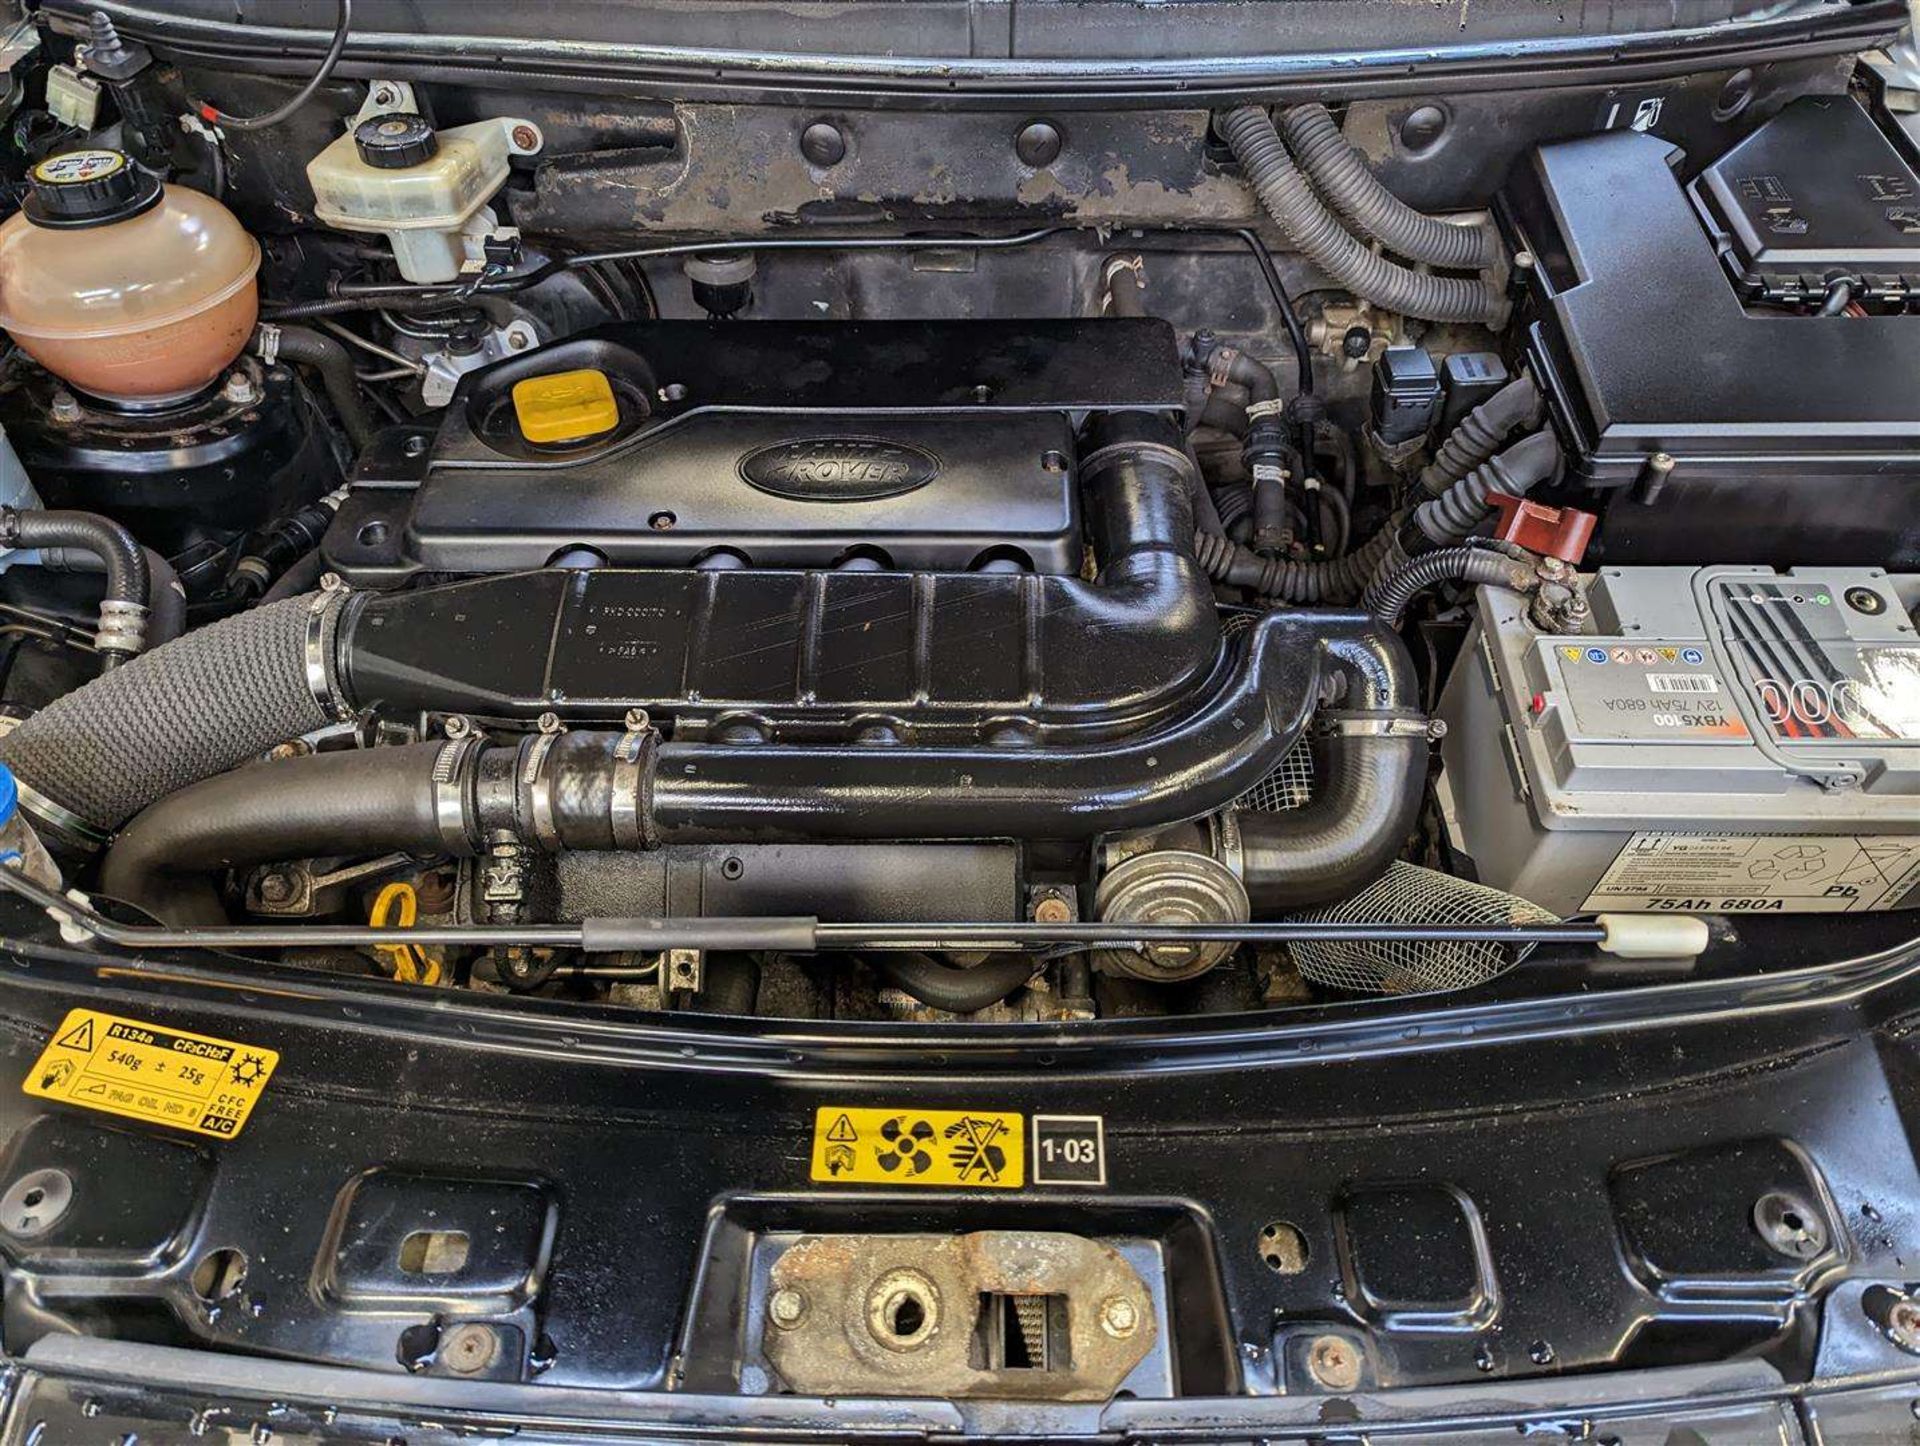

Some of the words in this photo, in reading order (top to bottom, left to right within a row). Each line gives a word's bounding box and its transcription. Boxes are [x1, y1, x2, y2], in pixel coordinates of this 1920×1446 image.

[1601, 698, 1646, 711] 680A
[1650, 699, 1690, 712] 75Ah
[1697, 700, 1724, 712] 12V
[1653, 714, 1730, 727] YBX5100
[1822, 885, 1859, 897] Pb
[1646, 899, 1711, 910] 75Ah
[1720, 899, 1784, 910] 680A
[110, 1025, 154, 1044] R134a
[107, 1050, 142, 1071] 540g
[178, 1066, 205, 1085] 25g
[218, 1094, 245, 1107] CFC
[208, 1104, 244, 1119] FREE
[203, 1117, 234, 1132] A/C
